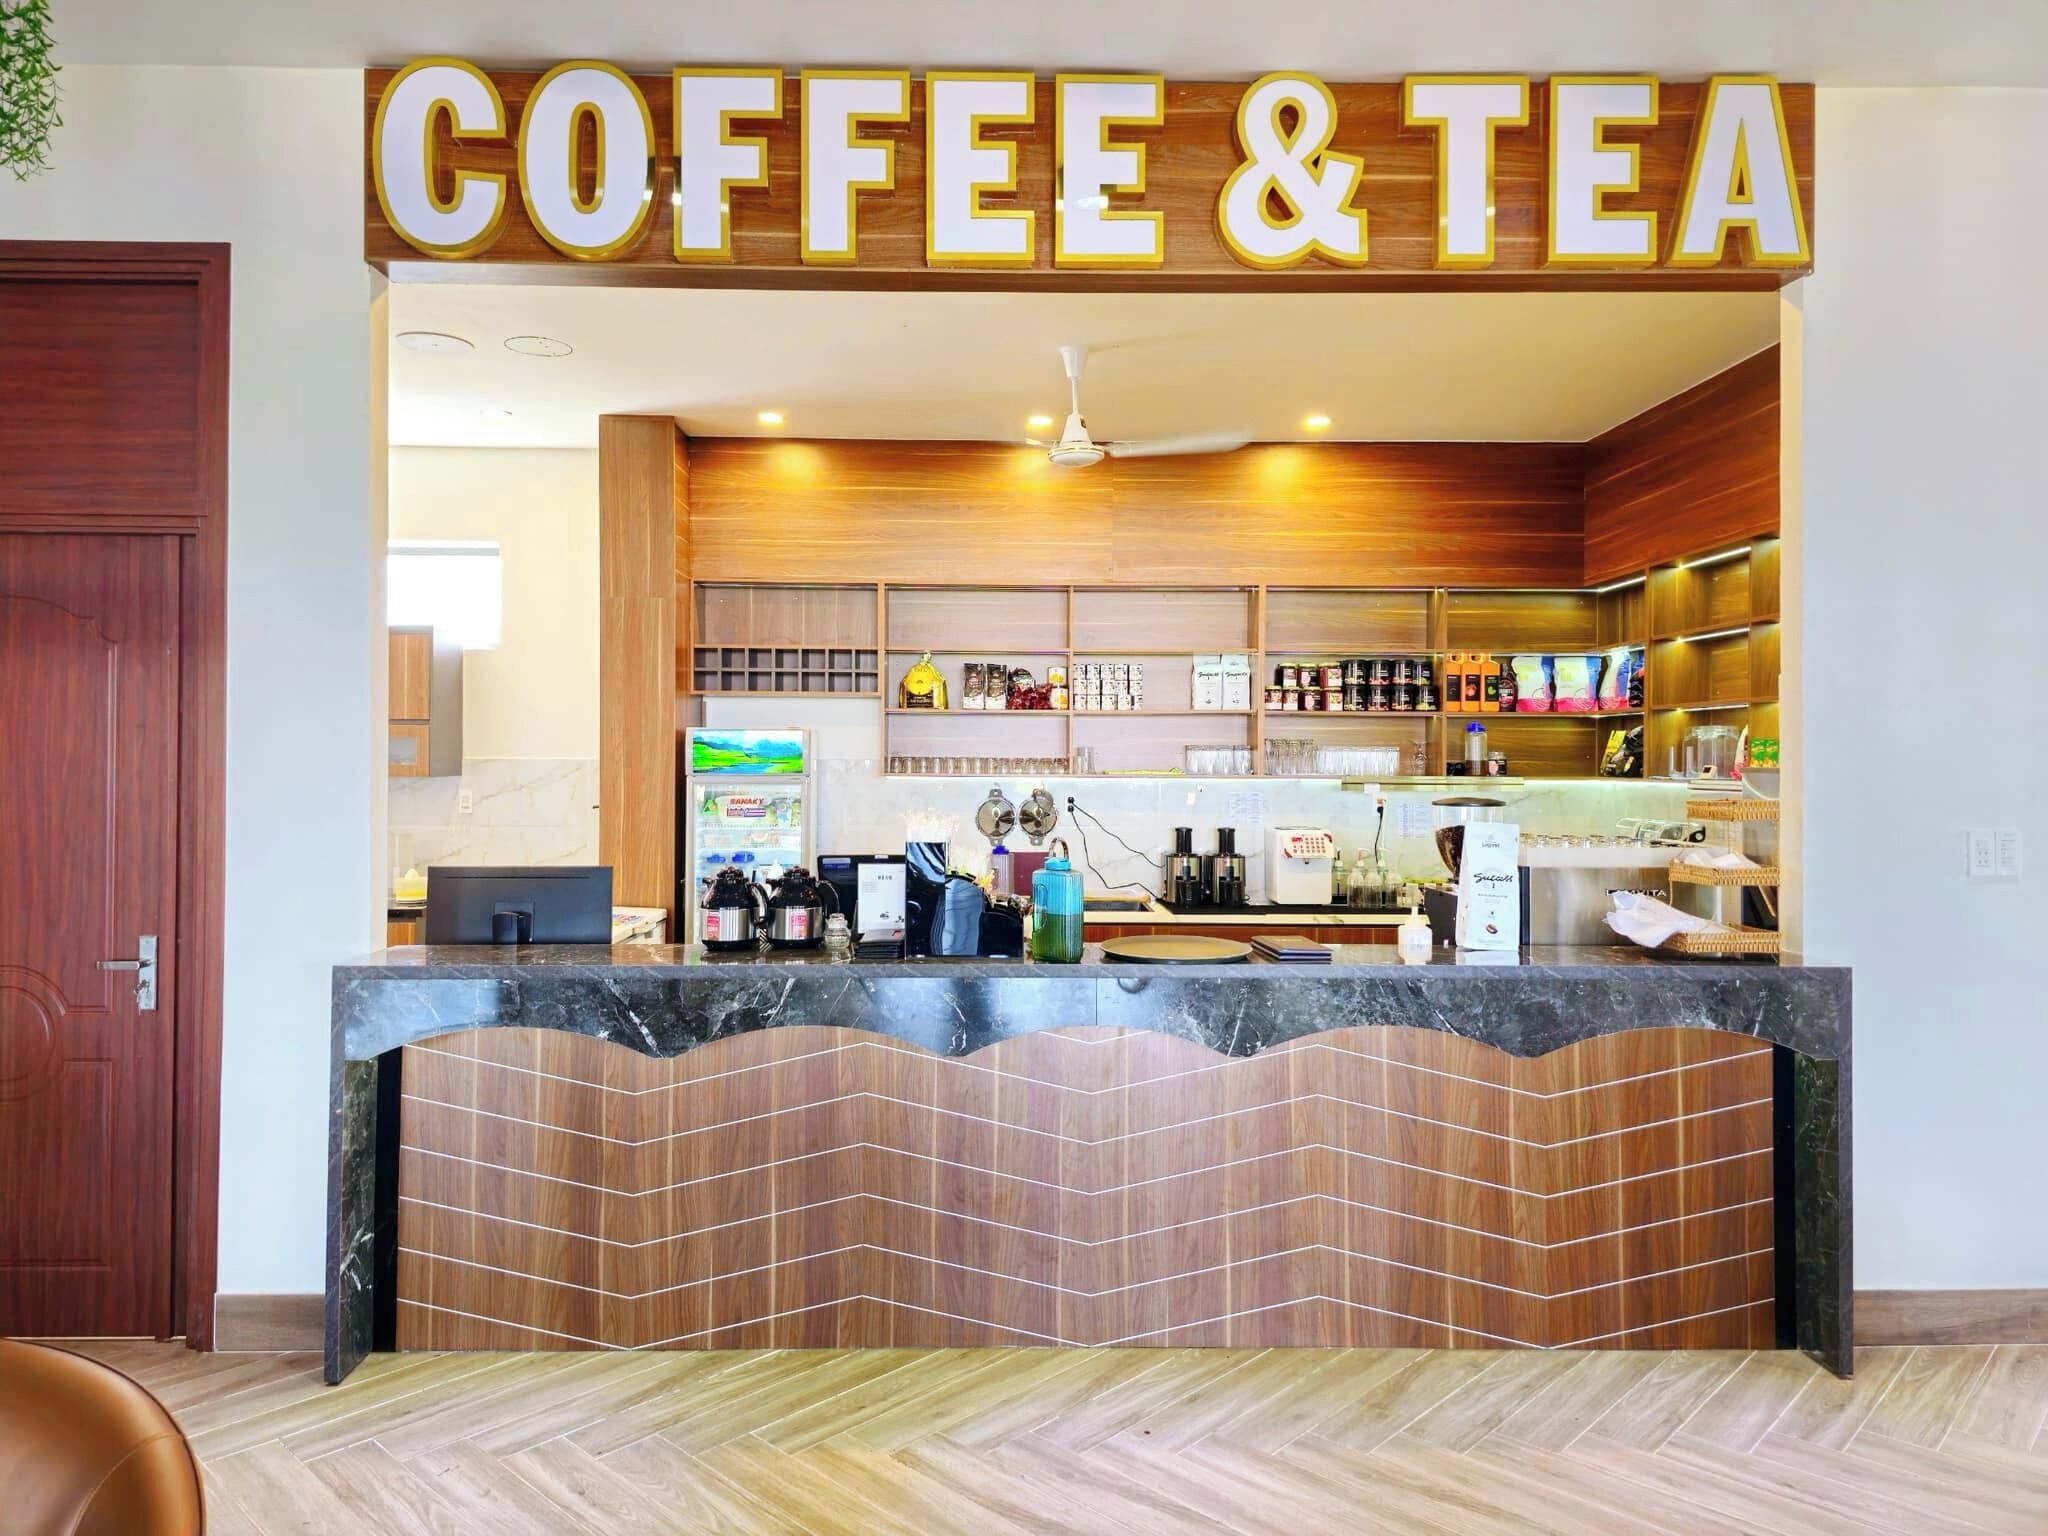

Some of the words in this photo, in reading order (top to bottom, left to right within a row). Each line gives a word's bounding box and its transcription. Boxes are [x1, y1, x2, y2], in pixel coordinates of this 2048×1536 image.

[372, 57, 1164, 266] COFFEE
[1215, 71, 1369, 268] &
[1404, 74, 1810, 268] TEA
